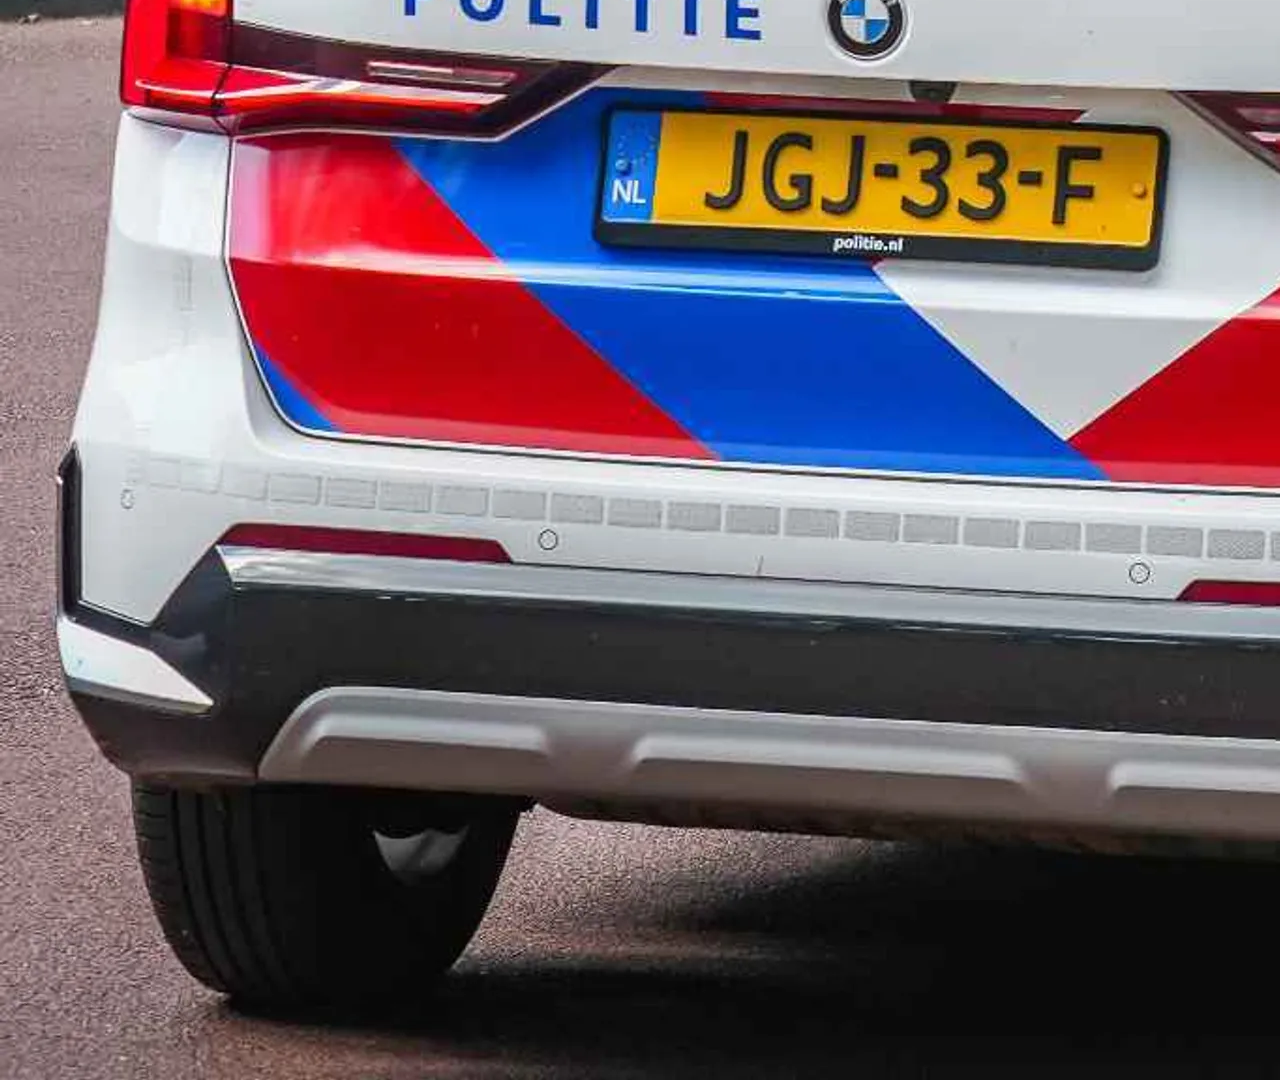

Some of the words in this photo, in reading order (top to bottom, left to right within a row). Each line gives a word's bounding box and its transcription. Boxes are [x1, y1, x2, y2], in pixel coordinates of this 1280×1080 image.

[704, 130, 1103, 225] JGJ-33-F
[611, 179, 646, 205] NL
[833, 235, 904, 253] politie.nl
